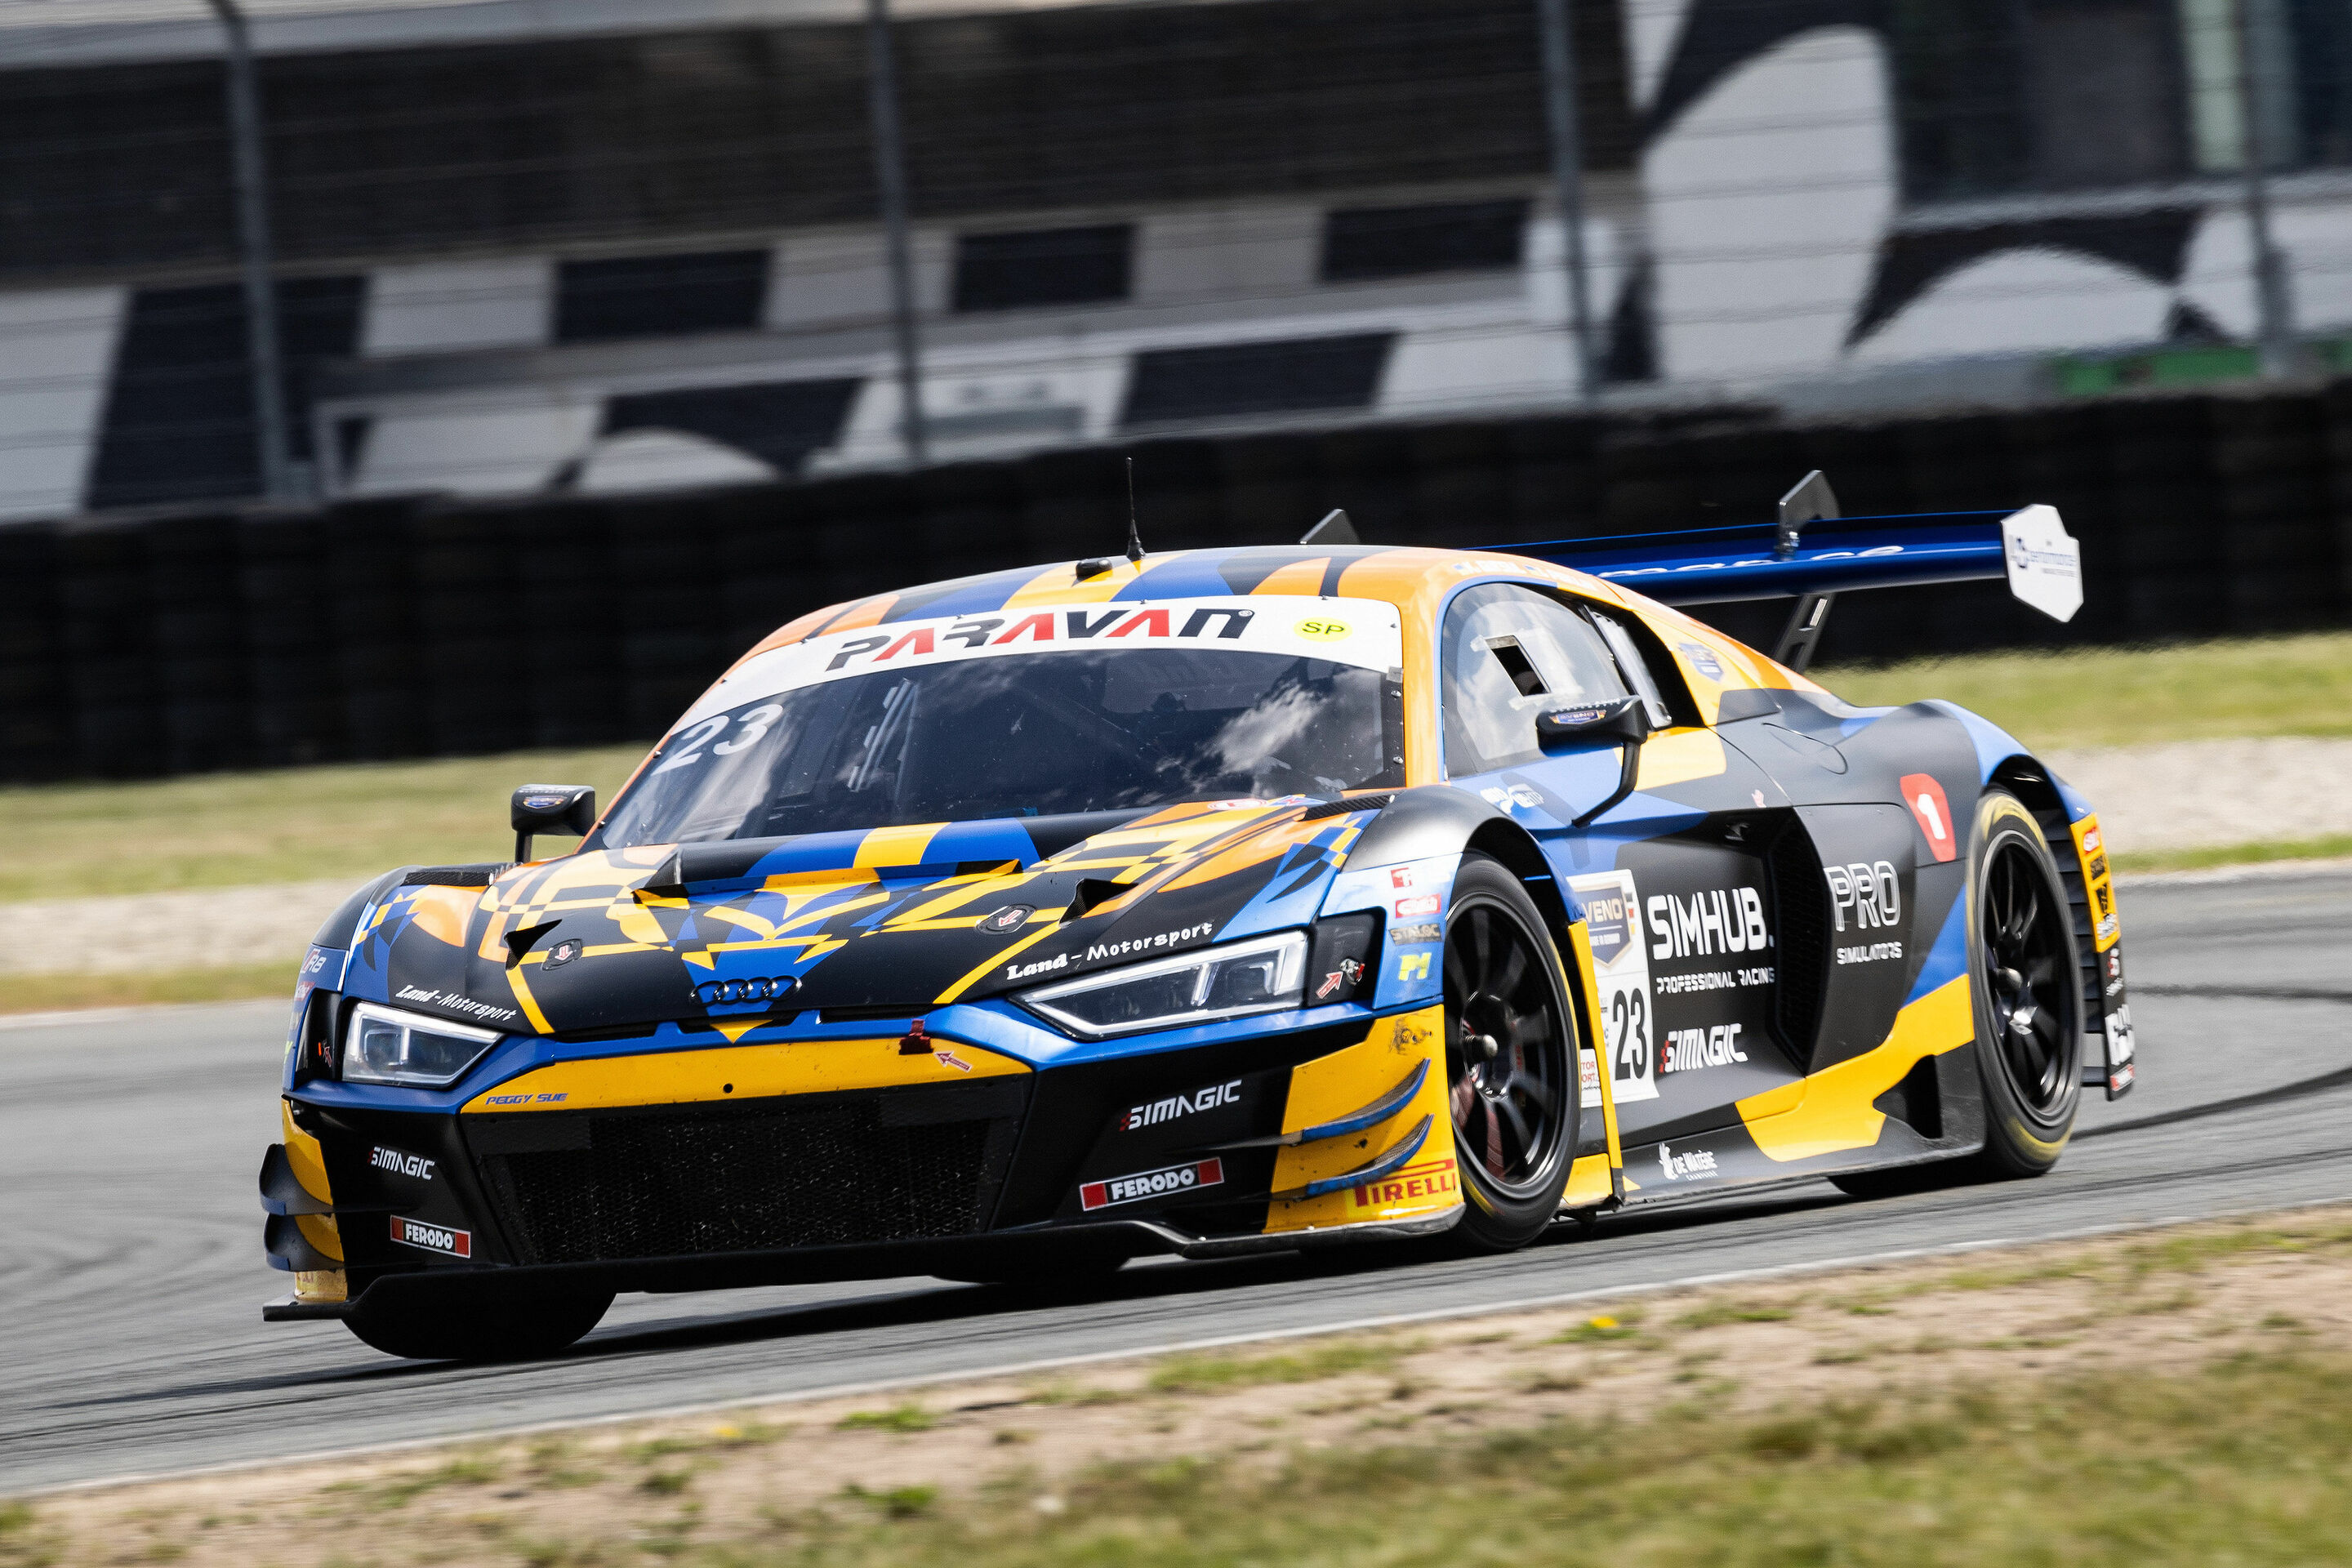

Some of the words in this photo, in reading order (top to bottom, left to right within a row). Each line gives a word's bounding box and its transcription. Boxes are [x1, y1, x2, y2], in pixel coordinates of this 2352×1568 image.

[825, 608, 1255, 672] PARAVAN
[1302, 621, 1345, 635] SP
[651, 704, 784, 776] 23
[1823, 860, 1901, 932] PRO
[1582, 898, 1624, 924] VENO
[1836, 941, 1903, 964] SIMULATORS
[1656, 971, 1736, 995] PROFESSIONAL
[1613, 987, 1648, 1080] 23
[1660, 1022, 1748, 1073] SIMAGIC
[1581, 1061, 1595, 1071] TOR
[1581, 1072, 1596, 1083] ORT
[485, 1094, 534, 1106] PEGGY
[535, 1093, 569, 1103] SUE
[1120, 1079, 1242, 1132] SIMAGIC
[368, 1146, 435, 1180] SIMAGIC
[1111, 1168, 1196, 1200] FERODO
[405, 1223, 453, 1250] FERODO
